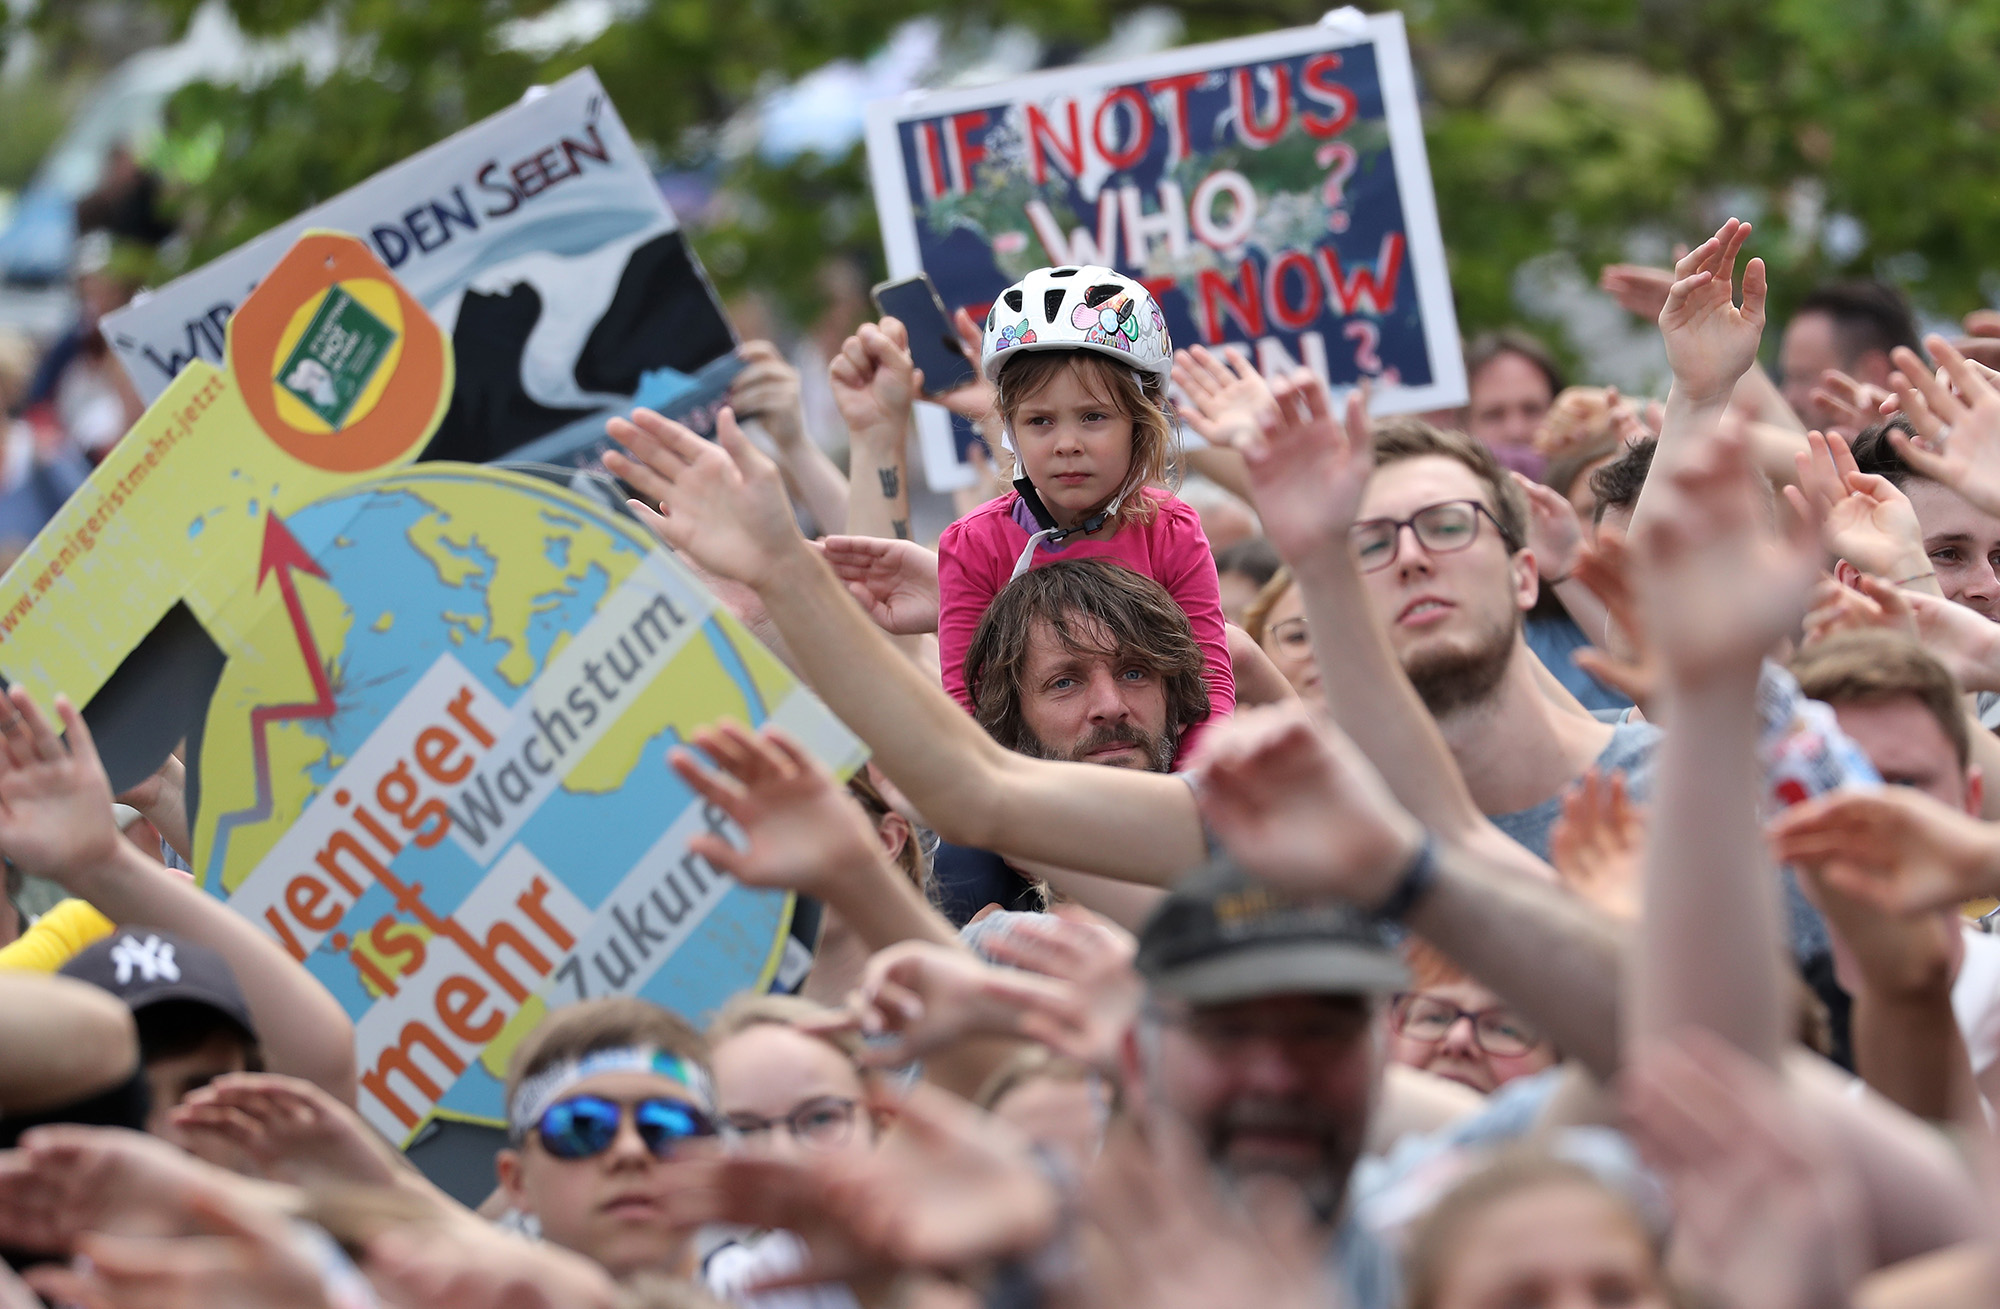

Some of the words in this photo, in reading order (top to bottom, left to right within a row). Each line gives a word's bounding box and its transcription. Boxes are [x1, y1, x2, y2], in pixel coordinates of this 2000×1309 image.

[914, 111, 990, 200] IF
[1023, 72, 1210, 186] NOT
[1229, 52, 1359, 150] US
[1024, 169, 1258, 268] WHO
[1192, 231, 1407, 345] NOW
[0, 374, 226, 644] ww.wenigeristmehr.jetzt
[448, 592, 687, 849] Wachstum
[330, 880, 455, 998] ist
[554, 797, 740, 1002] Zukunf
[360, 875, 577, 1131] mehr
